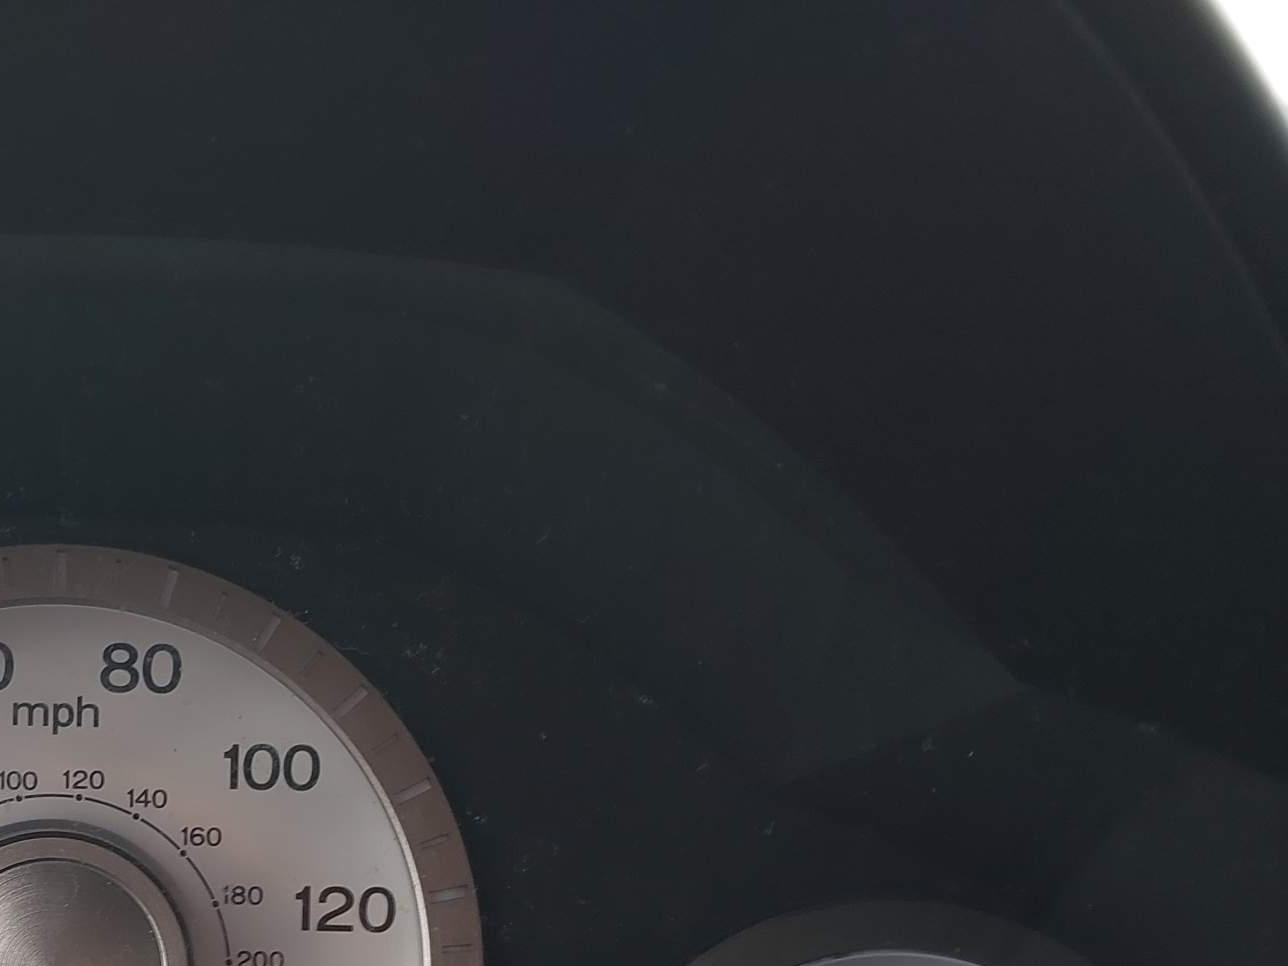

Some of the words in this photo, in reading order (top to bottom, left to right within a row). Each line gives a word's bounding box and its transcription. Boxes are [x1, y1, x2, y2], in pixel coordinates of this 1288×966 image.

[100, 642, 182, 694] 80
[12, 696, 99, 735] mph
[63, 770, 104, 790] 120
[223, 743, 320, 791] 100
[127, 789, 167, 809] 140
[181, 827, 221, 846] 160
[223, 886, 263, 905] 180
[295, 886, 396, 933] 120
